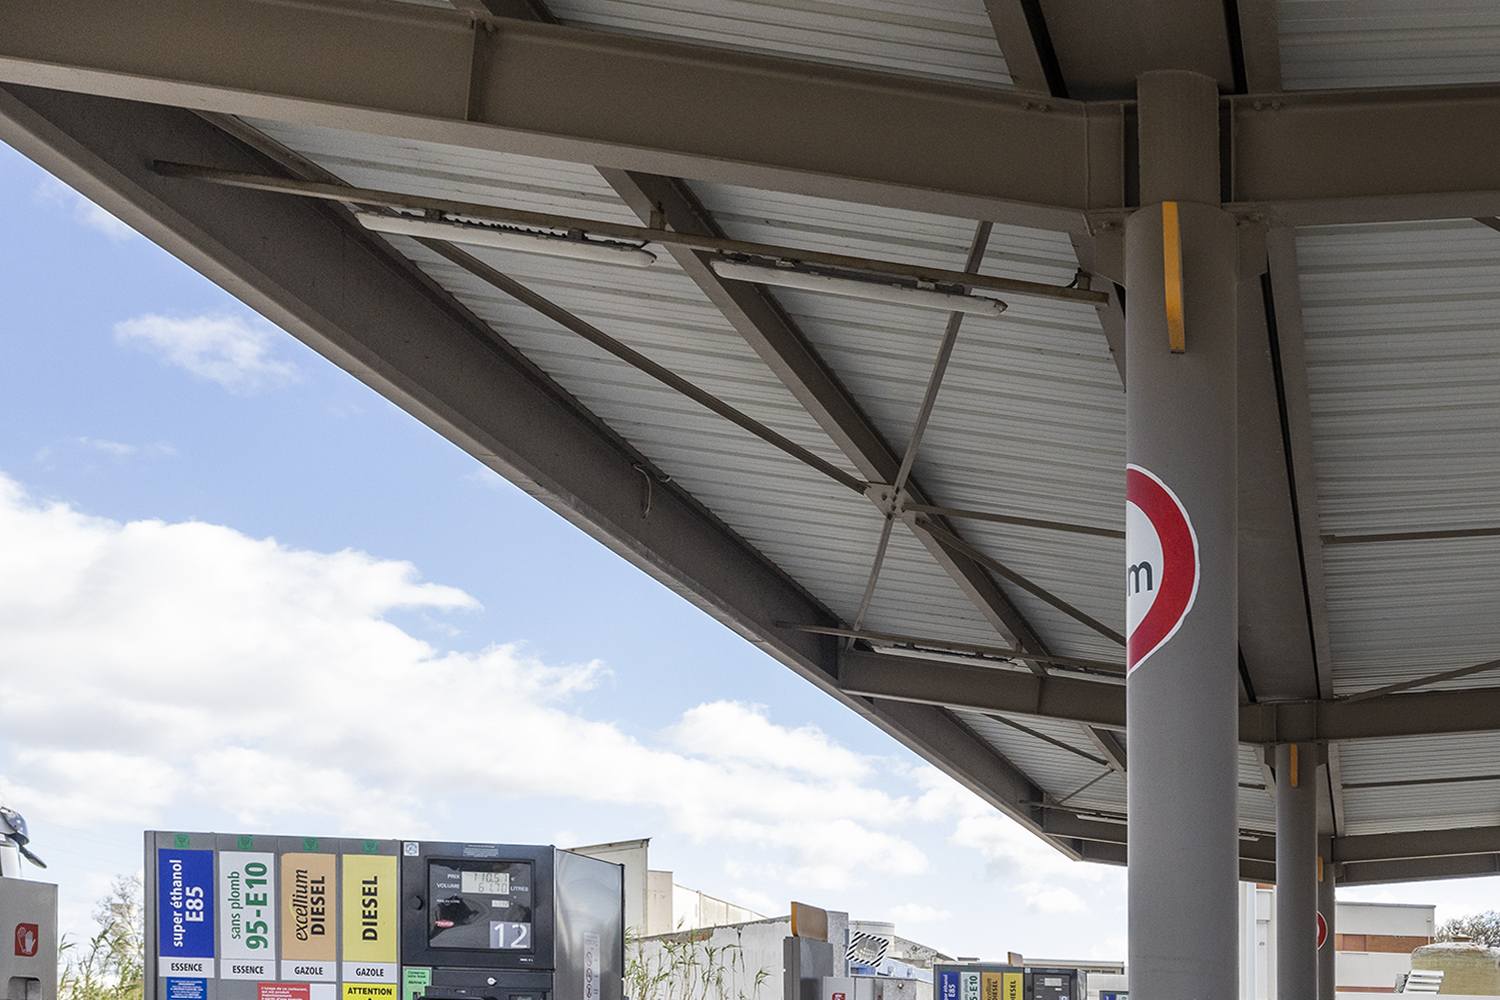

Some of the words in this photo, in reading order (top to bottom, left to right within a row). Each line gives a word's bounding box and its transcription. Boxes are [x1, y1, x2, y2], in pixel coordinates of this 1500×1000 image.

[169, 860, 182, 908] éthanol
[227, 871, 243, 909] plomb
[185, 886, 204, 922] E85
[244, 862, 268, 950] 95-E10
[292, 869, 308, 942] excellium
[310, 876, 325, 936] DIESEL
[362, 876, 378, 941] DIESEL
[173, 911, 185, 947] super
[232, 913, 240, 939] sans
[494, 924, 527, 948] 12
[171, 963, 202, 972] ESSENCE
[232, 966, 264, 974] ESSENCE
[294, 966, 323, 975] GAZOLE
[356, 968, 384, 976] GAZOLE
[348, 987, 392, 996] ATTENTION
[948, 984, 956, 998] E85
